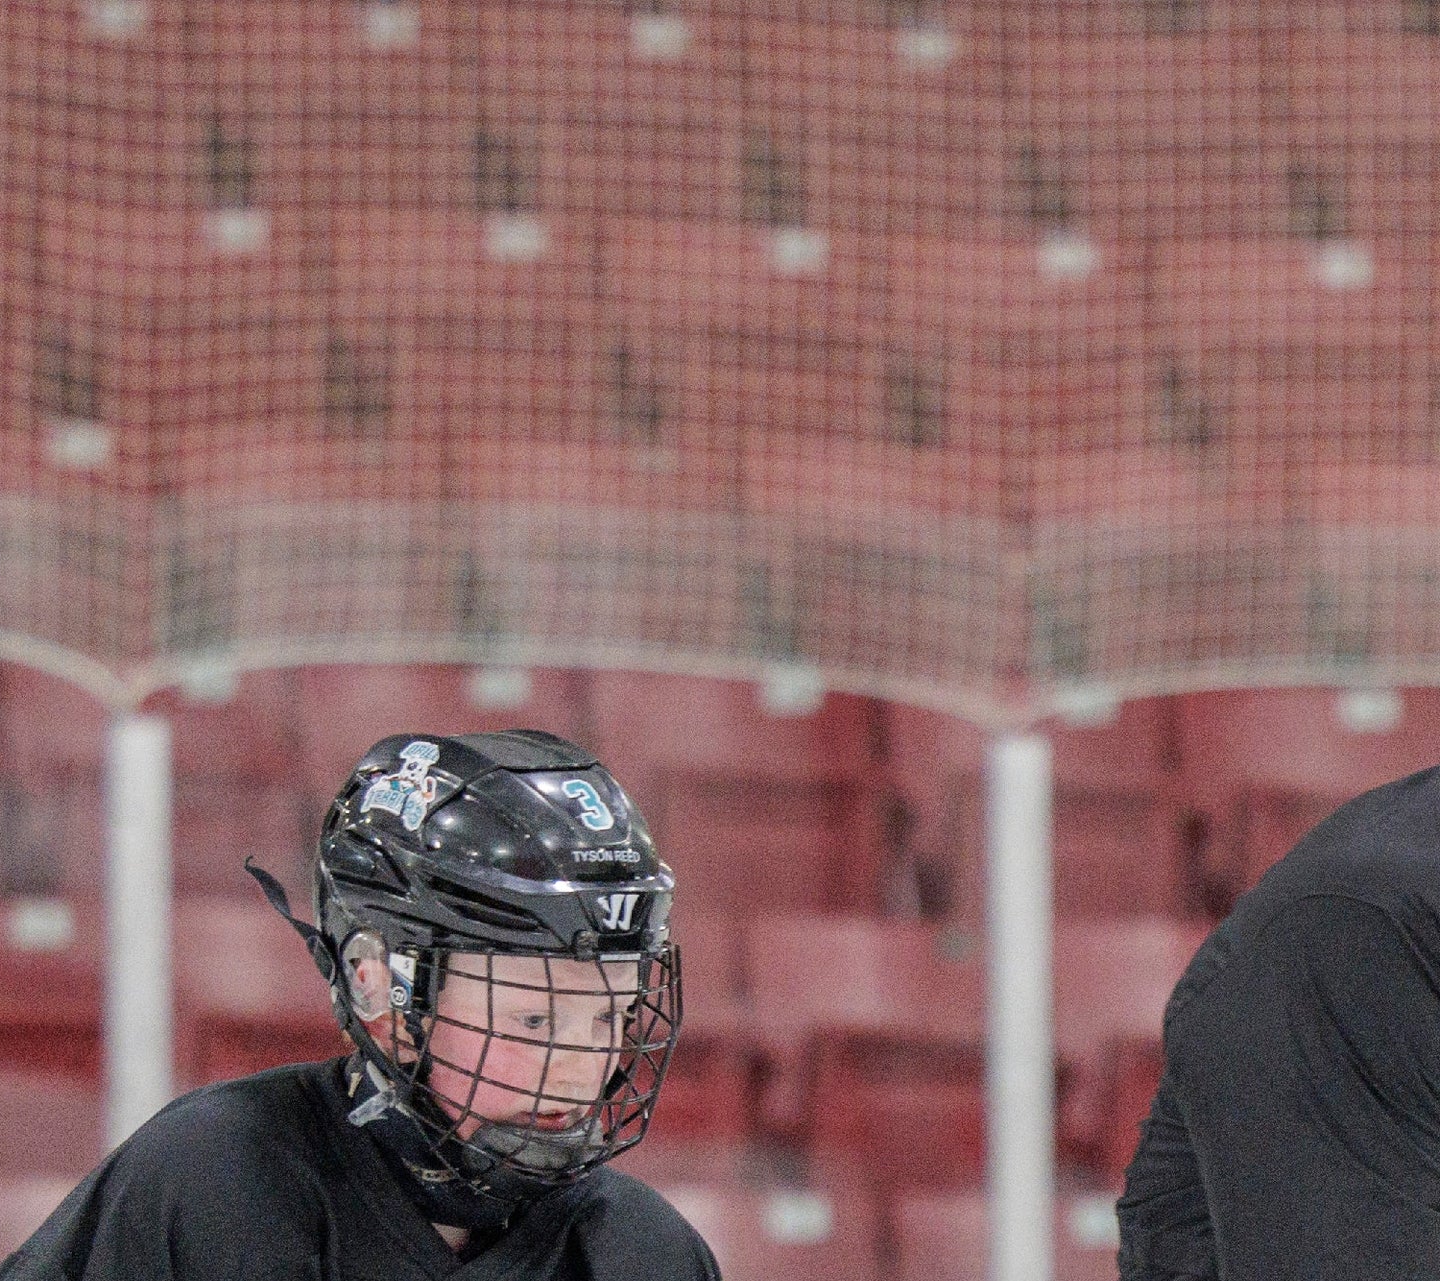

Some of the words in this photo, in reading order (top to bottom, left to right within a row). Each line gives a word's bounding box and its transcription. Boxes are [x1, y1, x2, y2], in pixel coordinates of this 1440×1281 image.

[563, 779, 615, 830] 3
[572, 848, 613, 863] TYSON
[614, 850, 641, 864] REED
